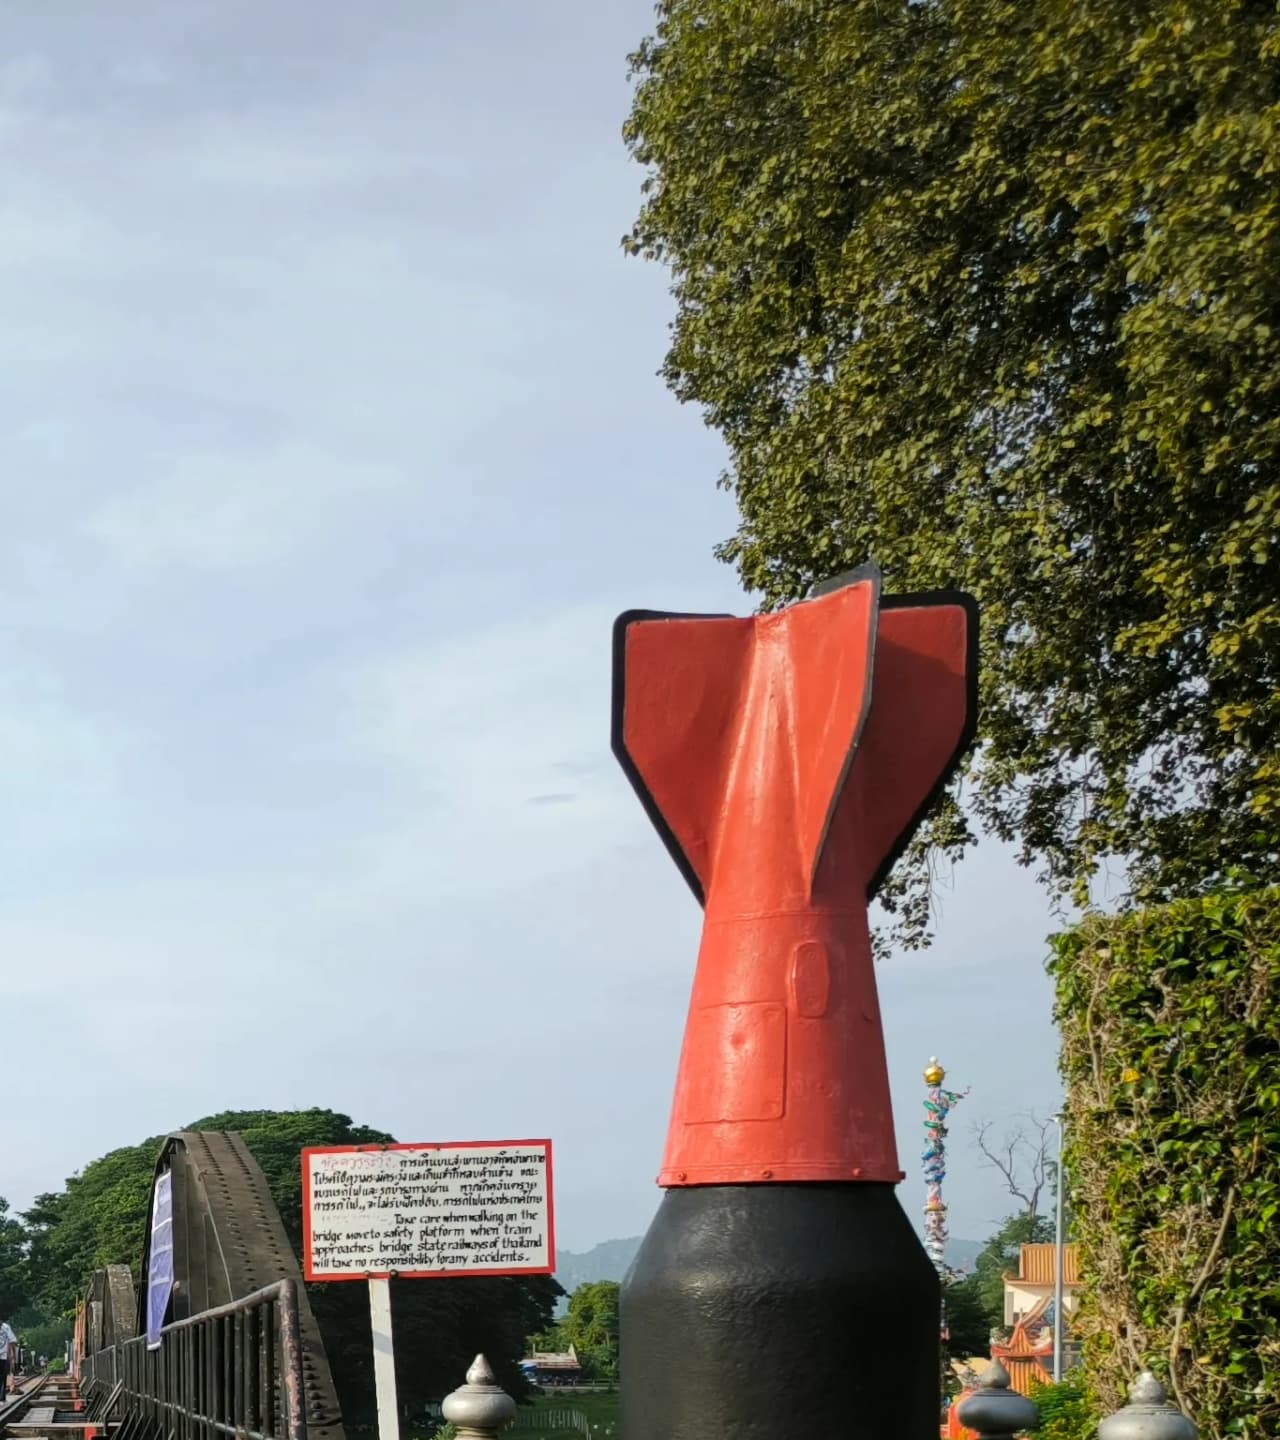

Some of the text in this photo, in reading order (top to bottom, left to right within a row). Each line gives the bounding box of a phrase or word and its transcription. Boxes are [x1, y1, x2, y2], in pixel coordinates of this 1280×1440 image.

[394, 1214, 417, 1224] Take
[420, 1215, 441, 1224] care
[443, 1211, 467, 1222] when
[469, 1209, 504, 1226] walking
[506, 1213, 517, 1221] on
[521, 1209, 538, 1220] the
[313, 1229, 343, 1246] bridge
[371, 1228, 380, 1239] to
[383, 1226, 414, 1240] safety
[419, 1224, 464, 1241] platform
[470, 1224, 499, 1236] when
[504, 1222, 532, 1234] train
[312, 1242, 374, 1257] approaches
[379, 1238, 413, 1256] bridge
[448, 1239, 488, 1251] railways
[489, 1236, 500, 1248] of
[313, 1257, 329, 1268] will
[331, 1258, 353, 1268] take
[355, 1258, 366, 1267] no
[369, 1253, 434, 1270] responsibility
